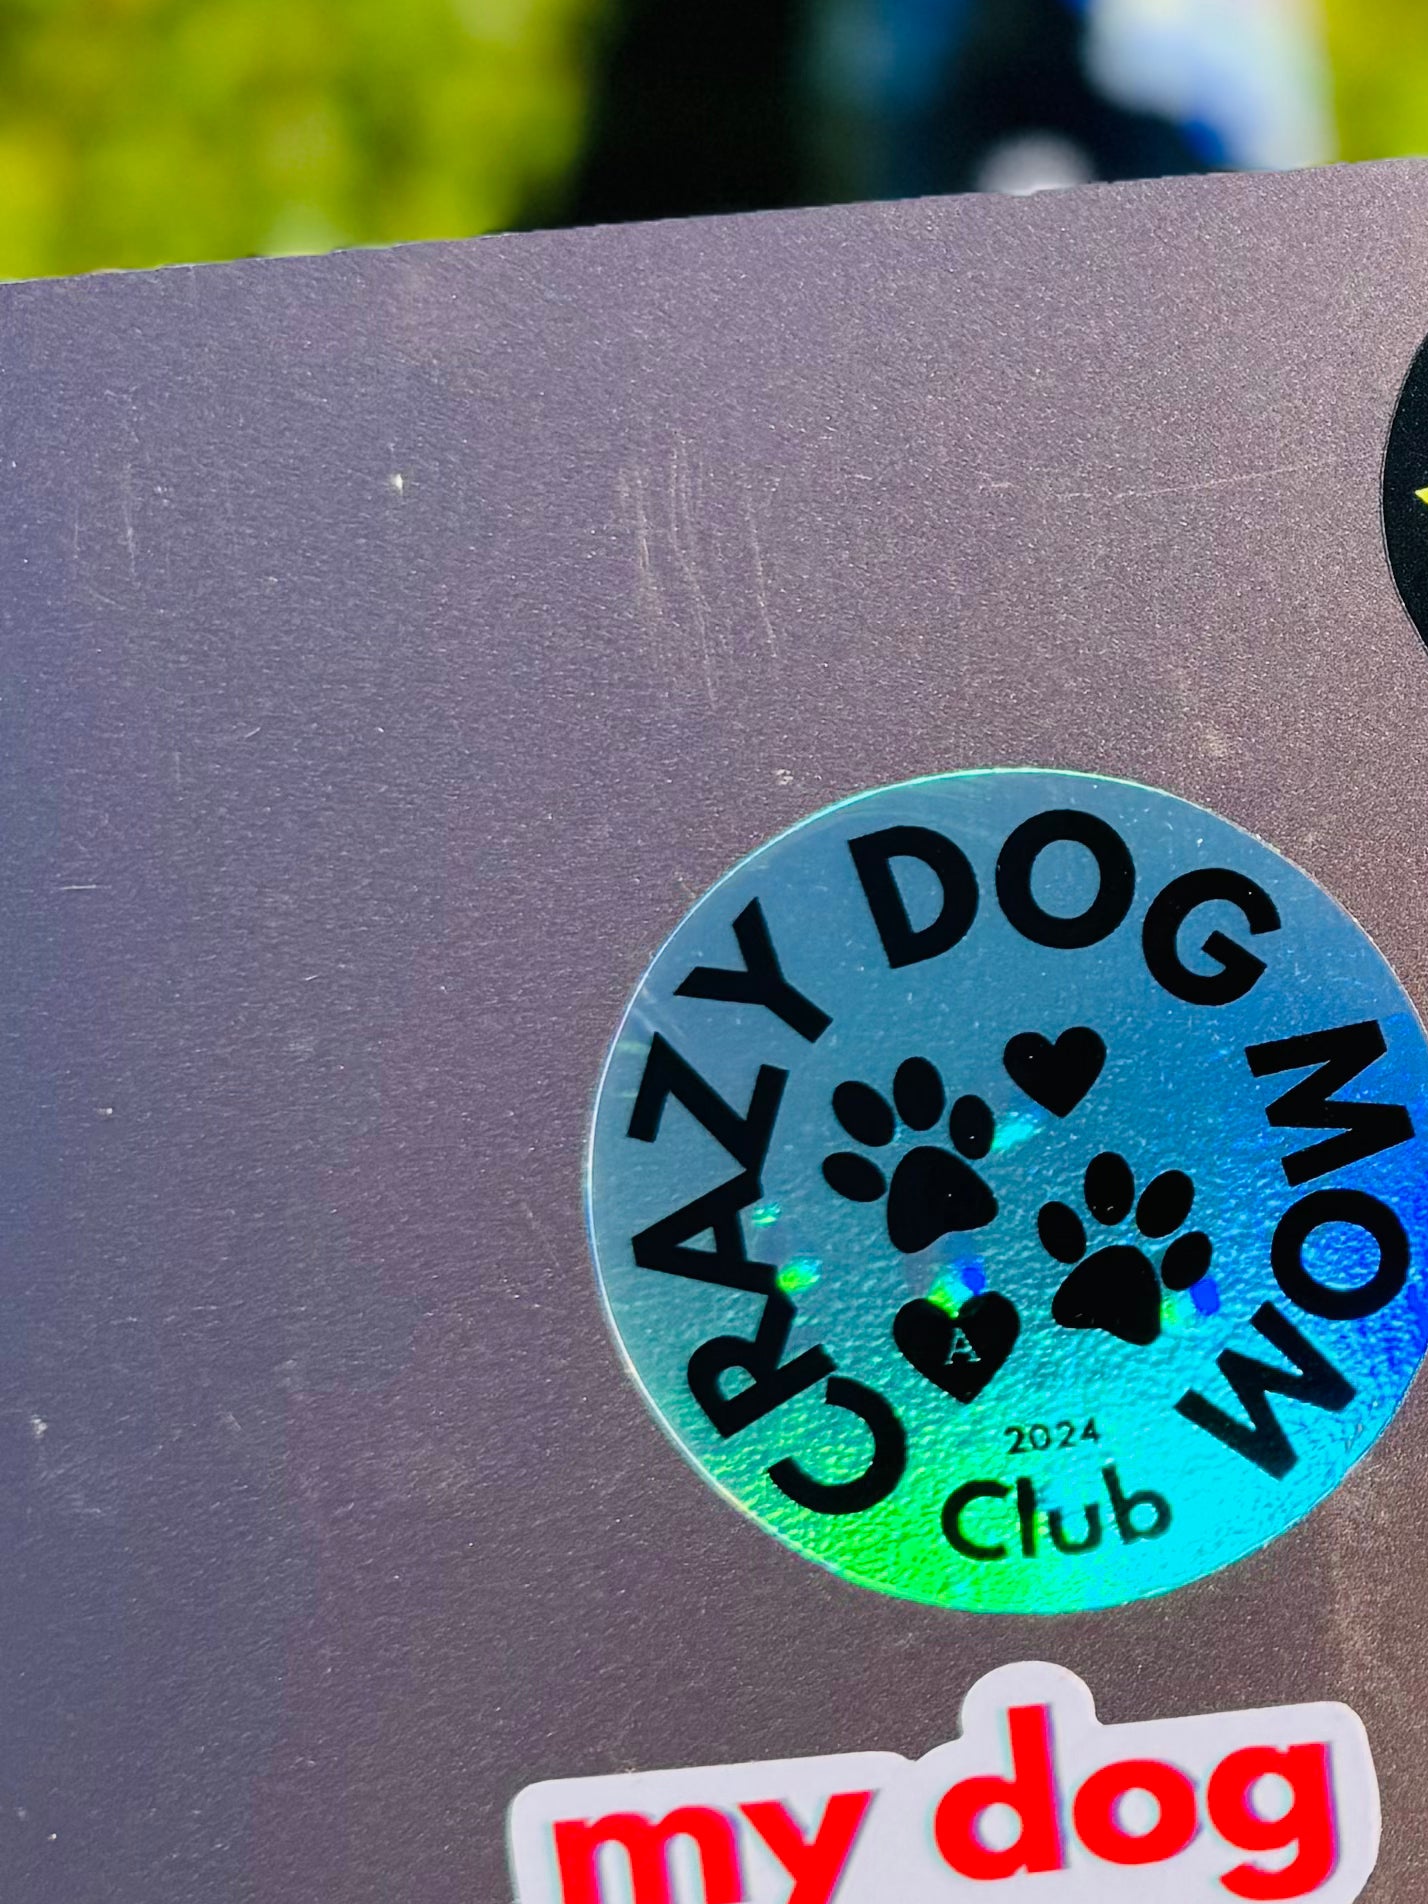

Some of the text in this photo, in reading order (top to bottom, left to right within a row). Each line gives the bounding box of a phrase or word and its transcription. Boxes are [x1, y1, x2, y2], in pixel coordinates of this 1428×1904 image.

[625, 808, 1417, 1517] CRAZY DOG MOM
[944, 1326, 982, 1366] A
[1003, 1416, 1101, 1455] 2024
[940, 1464, 1173, 1562] Club
[931, 1703, 1341, 1903] dog
